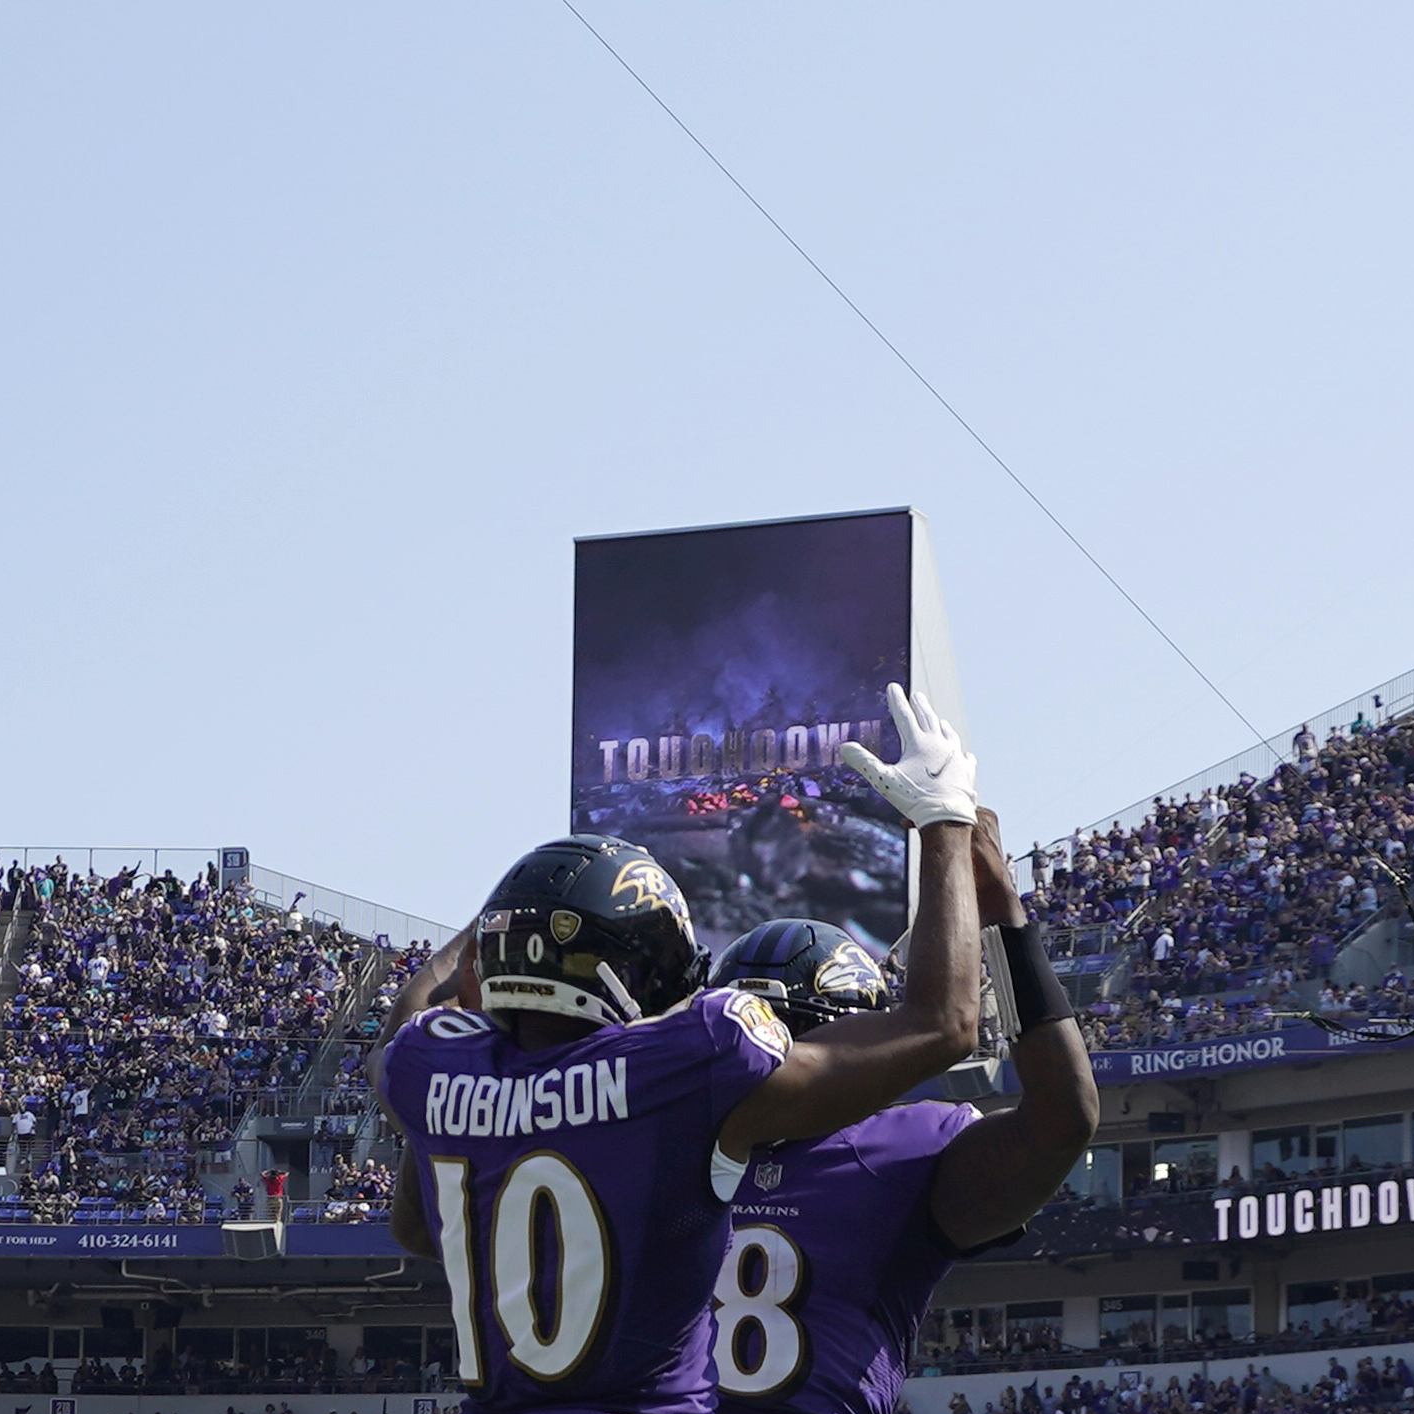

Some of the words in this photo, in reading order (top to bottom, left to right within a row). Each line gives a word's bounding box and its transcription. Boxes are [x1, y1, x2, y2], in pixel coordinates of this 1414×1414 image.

[599, 720, 885, 783] TOUCHDOWN
[489, 979, 556, 997] RAVENS
[1131, 1050, 1186, 1076] RING
[1201, 1036, 1286, 1069] HONOR
[426, 1057, 629, 1137] ROBINSON
[5, 1235, 28, 1245] FOR
[29, 1236, 58, 1246] HELP
[77, 1234, 178, 1248] 410-324-6141
[430, 1150, 612, 1388] 10
[713, 1222, 806, 1399] 8
